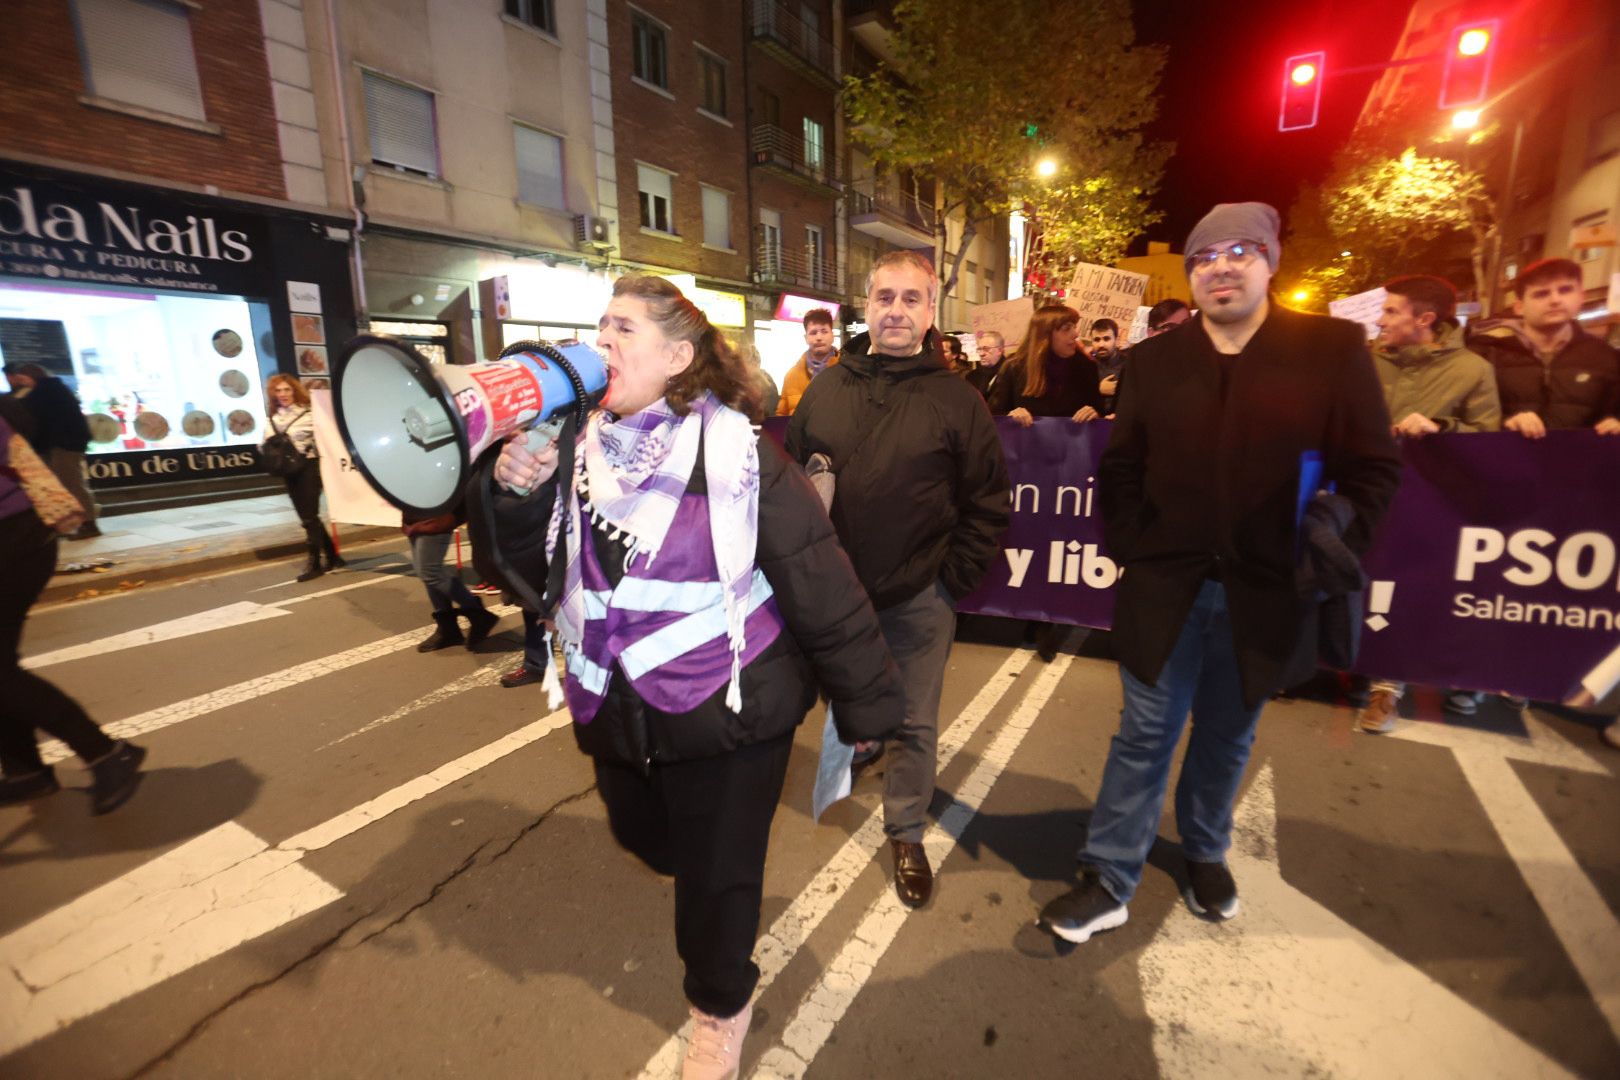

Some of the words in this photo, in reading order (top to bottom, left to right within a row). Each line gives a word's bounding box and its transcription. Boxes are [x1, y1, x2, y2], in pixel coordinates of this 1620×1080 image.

[97, 202, 253, 263] Nails
[72, 248, 88, 263] Y
[96, 251, 201, 275] PEDICURA
[142, 455, 180, 474] de
[186, 450, 255, 472] Uñas
[1010, 482, 1039, 514] n
[1004, 548, 1034, 588] y
[1454, 526, 1620, 592] PSO
